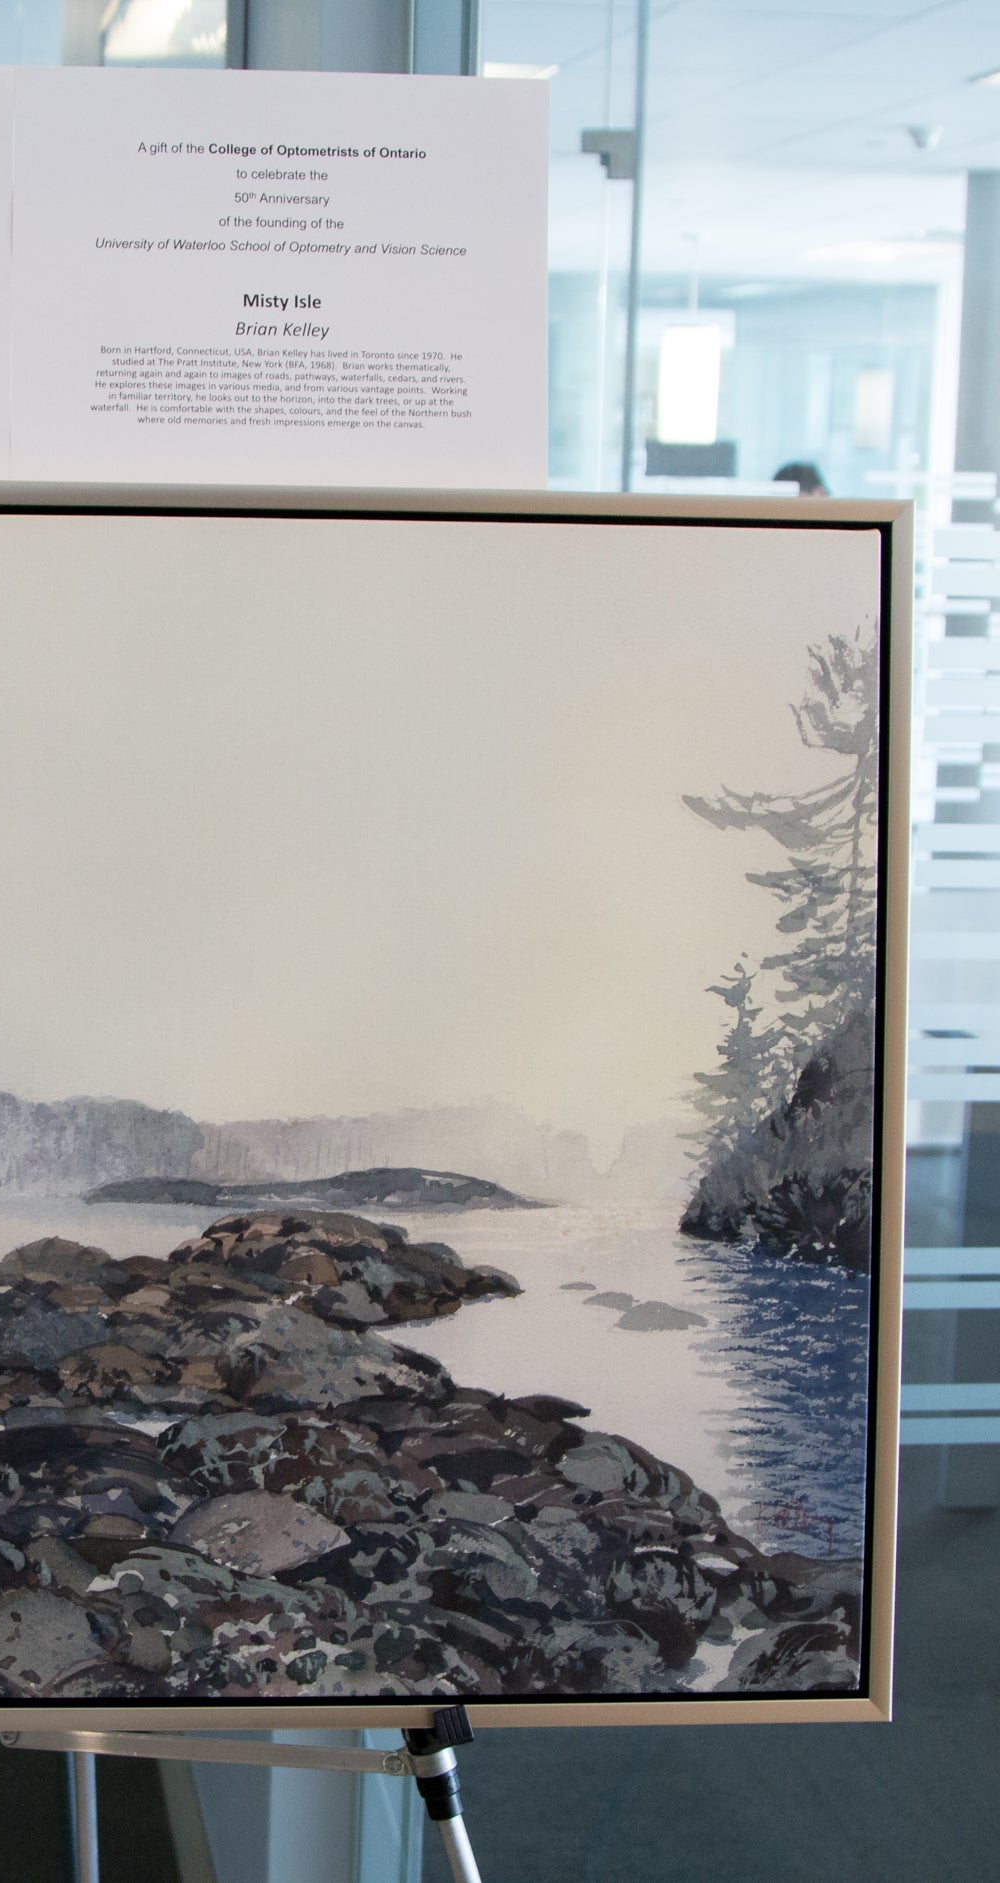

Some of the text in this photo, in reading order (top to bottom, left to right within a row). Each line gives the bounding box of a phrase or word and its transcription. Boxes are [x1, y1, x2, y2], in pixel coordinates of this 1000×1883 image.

[137, 141, 427, 160] A gift of the College of Optometrists of Ontario
[236, 168, 329, 181] to celebrate the
[258, 192, 330, 208] Anniversary
[218, 215, 345, 232] of the founding of the
[95, 237, 467, 257] University of Waterloo School of Optometry and Vision Science
[243, 293, 322, 312] Misty Isle
[235, 321, 330, 341] Brian Kelley
[100, 345, 463, 361] Born in Hartford, Connecticut, USA, Brian Kelley has lived in Toronto since 1970. He
[94, 380, 468, 397] He explores these images in various media, and from various vantage points. Working
